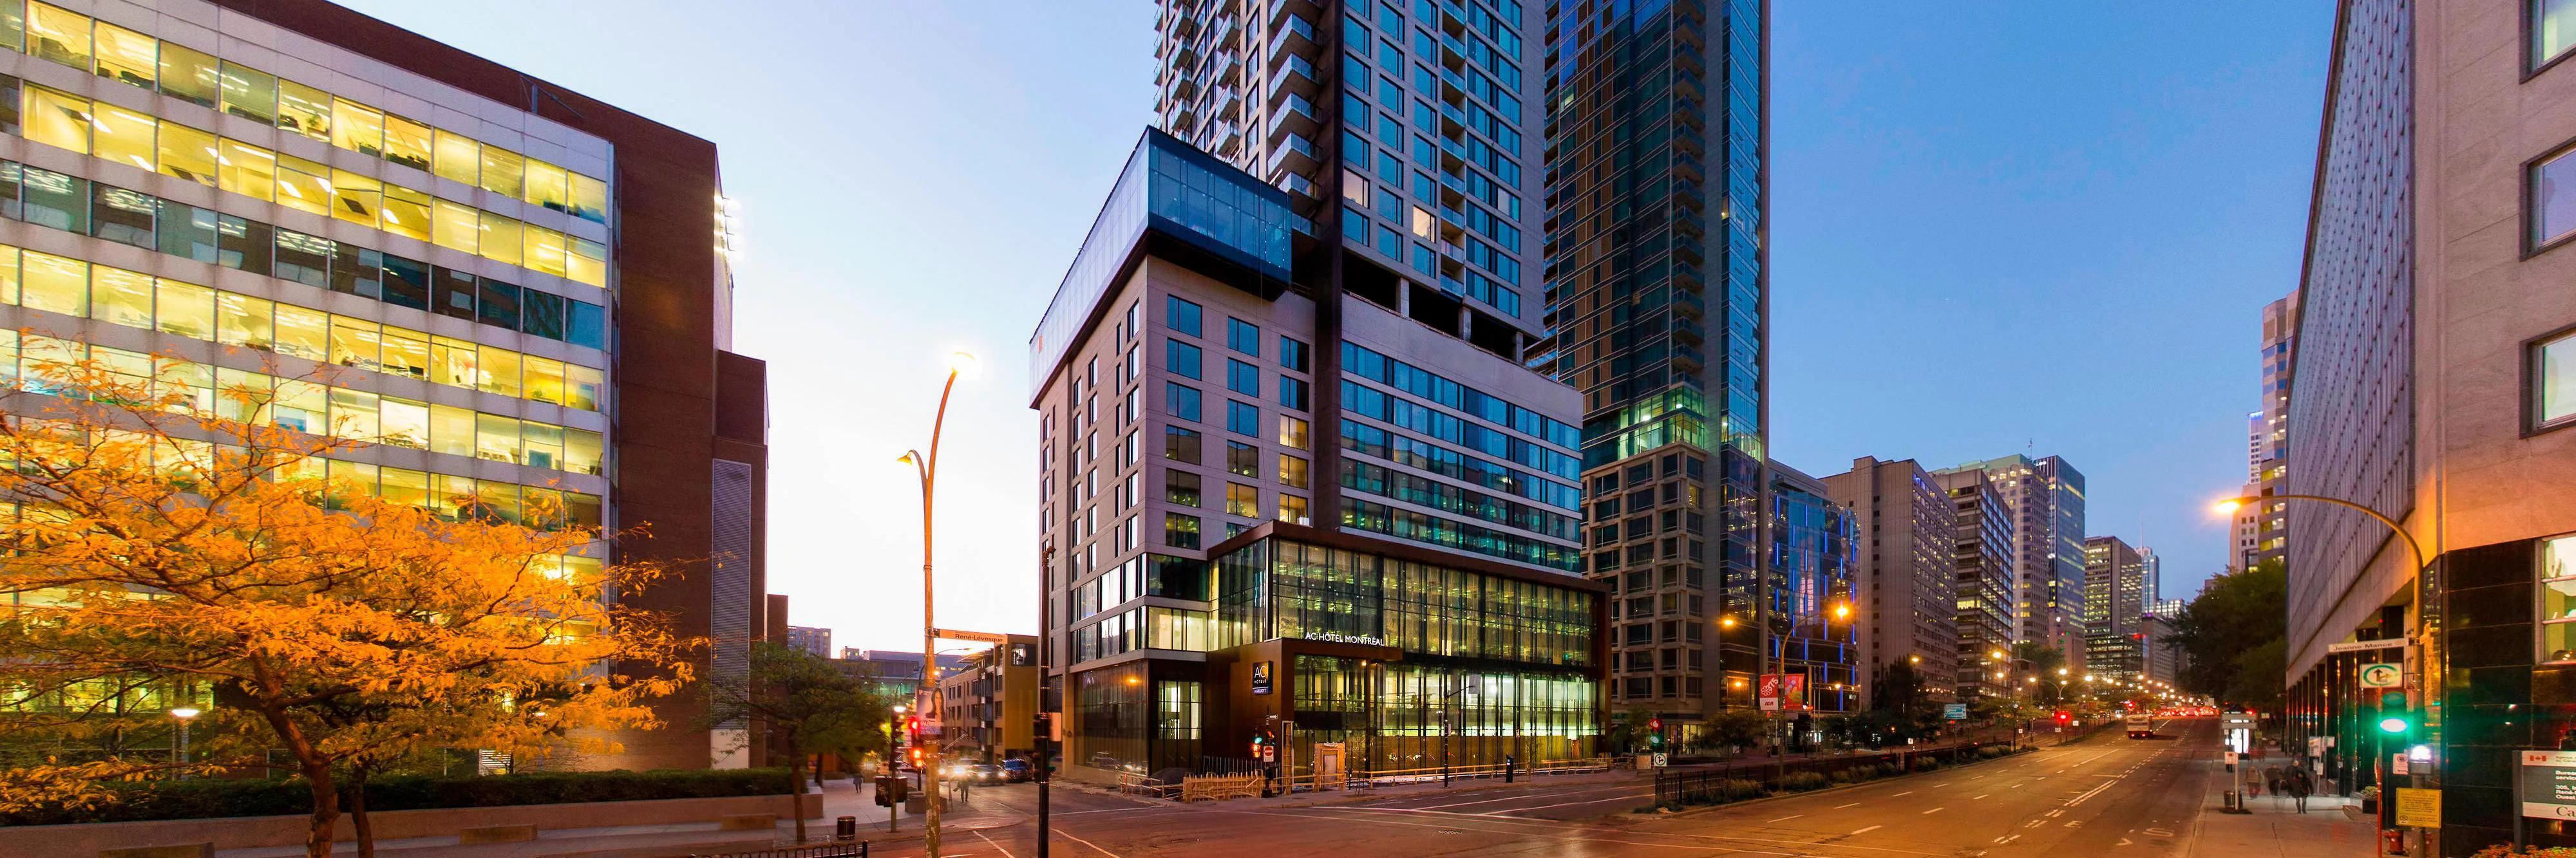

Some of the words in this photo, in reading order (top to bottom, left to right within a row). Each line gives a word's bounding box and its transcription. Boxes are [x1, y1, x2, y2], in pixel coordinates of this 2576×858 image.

[955, 633, 1003, 642] René-Lévesque
[1305, 631, 1318, 640] AC
[1318, 631, 1343, 643] HÔTEL
[1345, 635, 1385, 646] MONTRÉAL
[2333, 642, 2392, 651] Jeanne-Mance
[1254, 665, 1267, 678] AC
